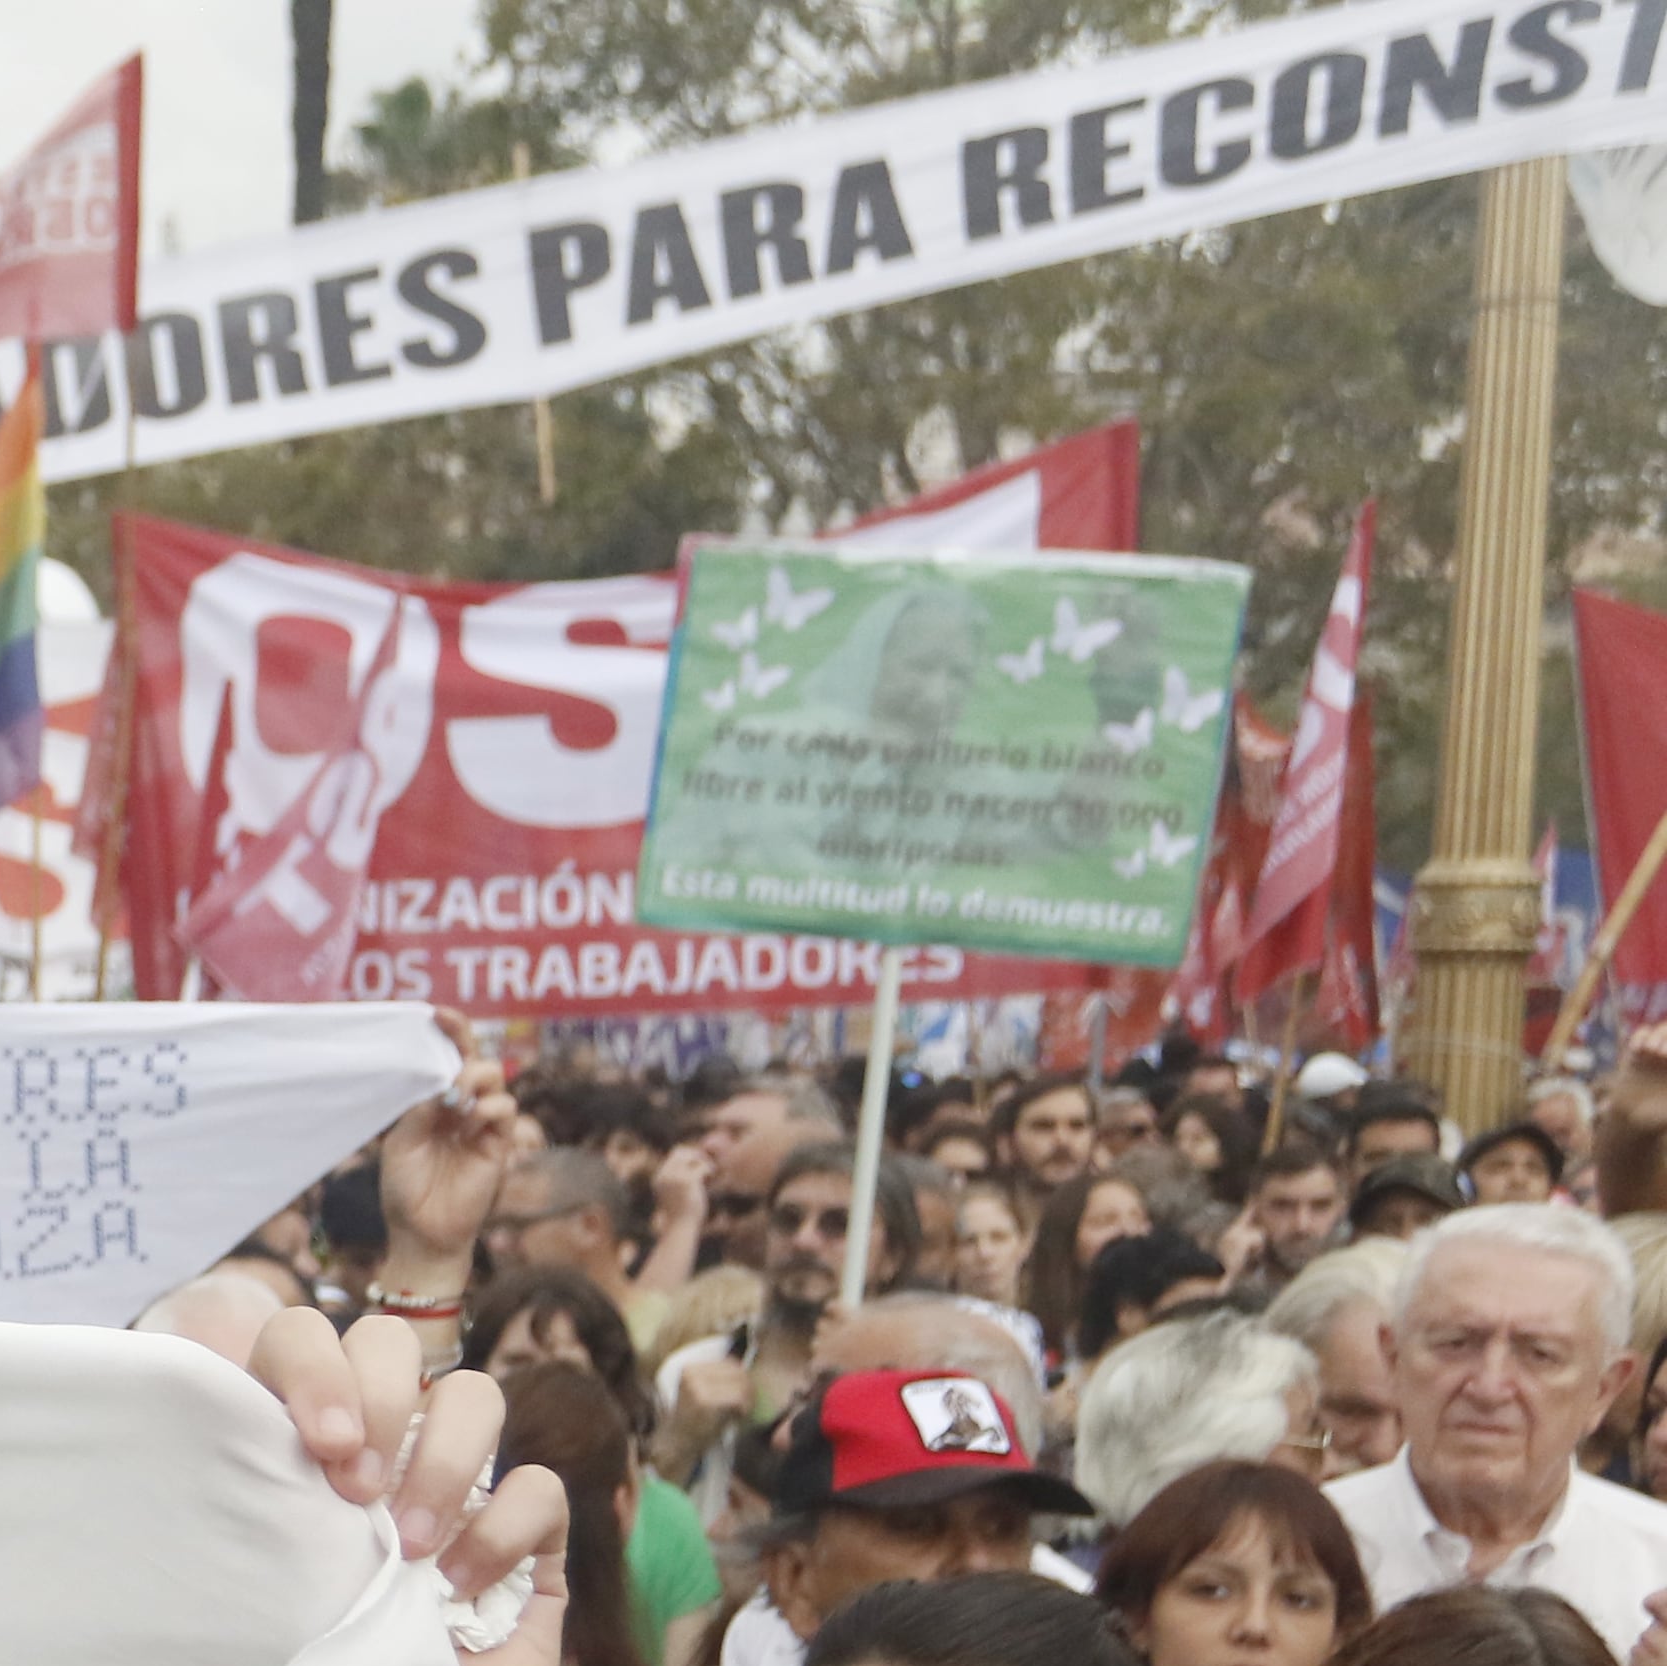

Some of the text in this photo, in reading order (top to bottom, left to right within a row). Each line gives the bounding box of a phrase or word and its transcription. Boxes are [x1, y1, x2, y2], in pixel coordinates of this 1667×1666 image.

[527, 158, 913, 346] PARA
[680, 770, 764, 802] libre
[776, 772, 809, 804] al
[661, 865, 736, 900] Esta
[745, 871, 909, 915] multitud
[915, 879, 952, 916] lo
[16, 1127, 145, 1199] LA
